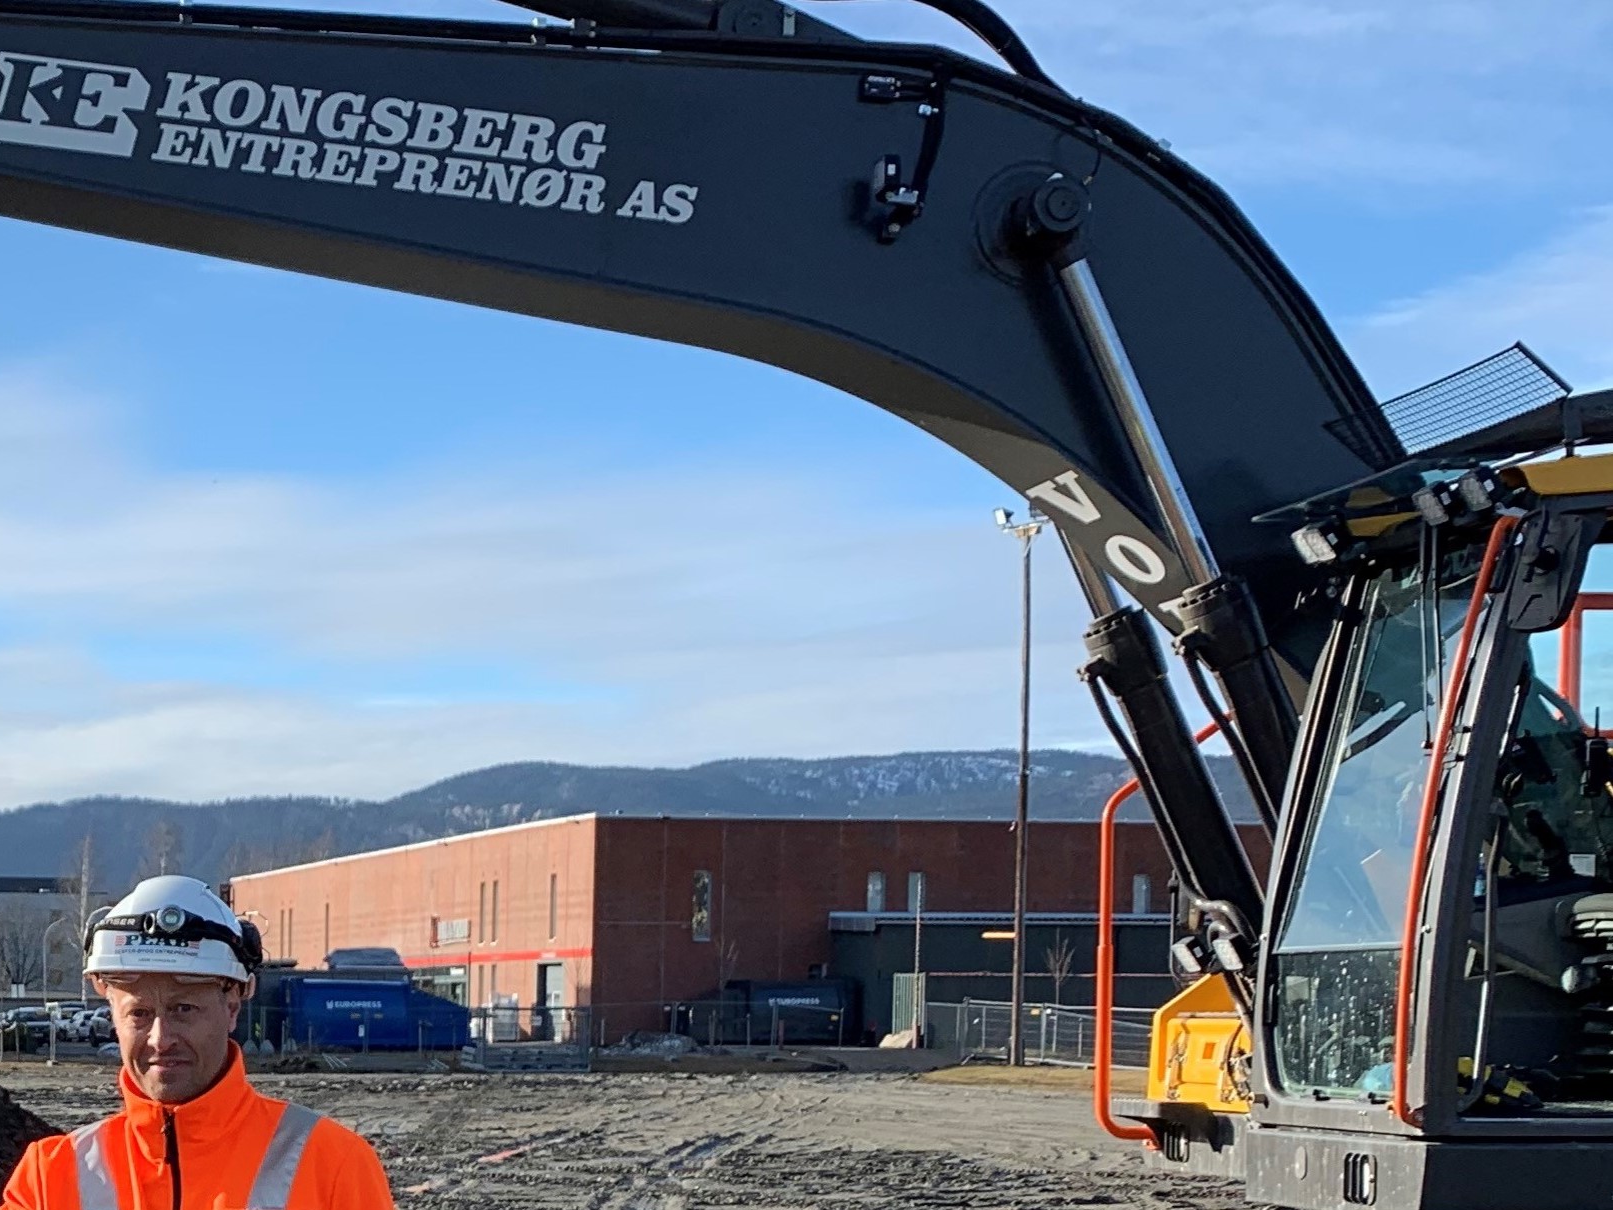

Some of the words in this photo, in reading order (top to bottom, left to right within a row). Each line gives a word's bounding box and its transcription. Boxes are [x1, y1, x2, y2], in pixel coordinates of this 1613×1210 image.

[156, 71, 607, 169] KONGSBERG
[151, 124, 606, 217] ENTREPRENØR
[616, 180, 699, 224] AS
[334, 1000, 383, 1008] EUROPRESS
